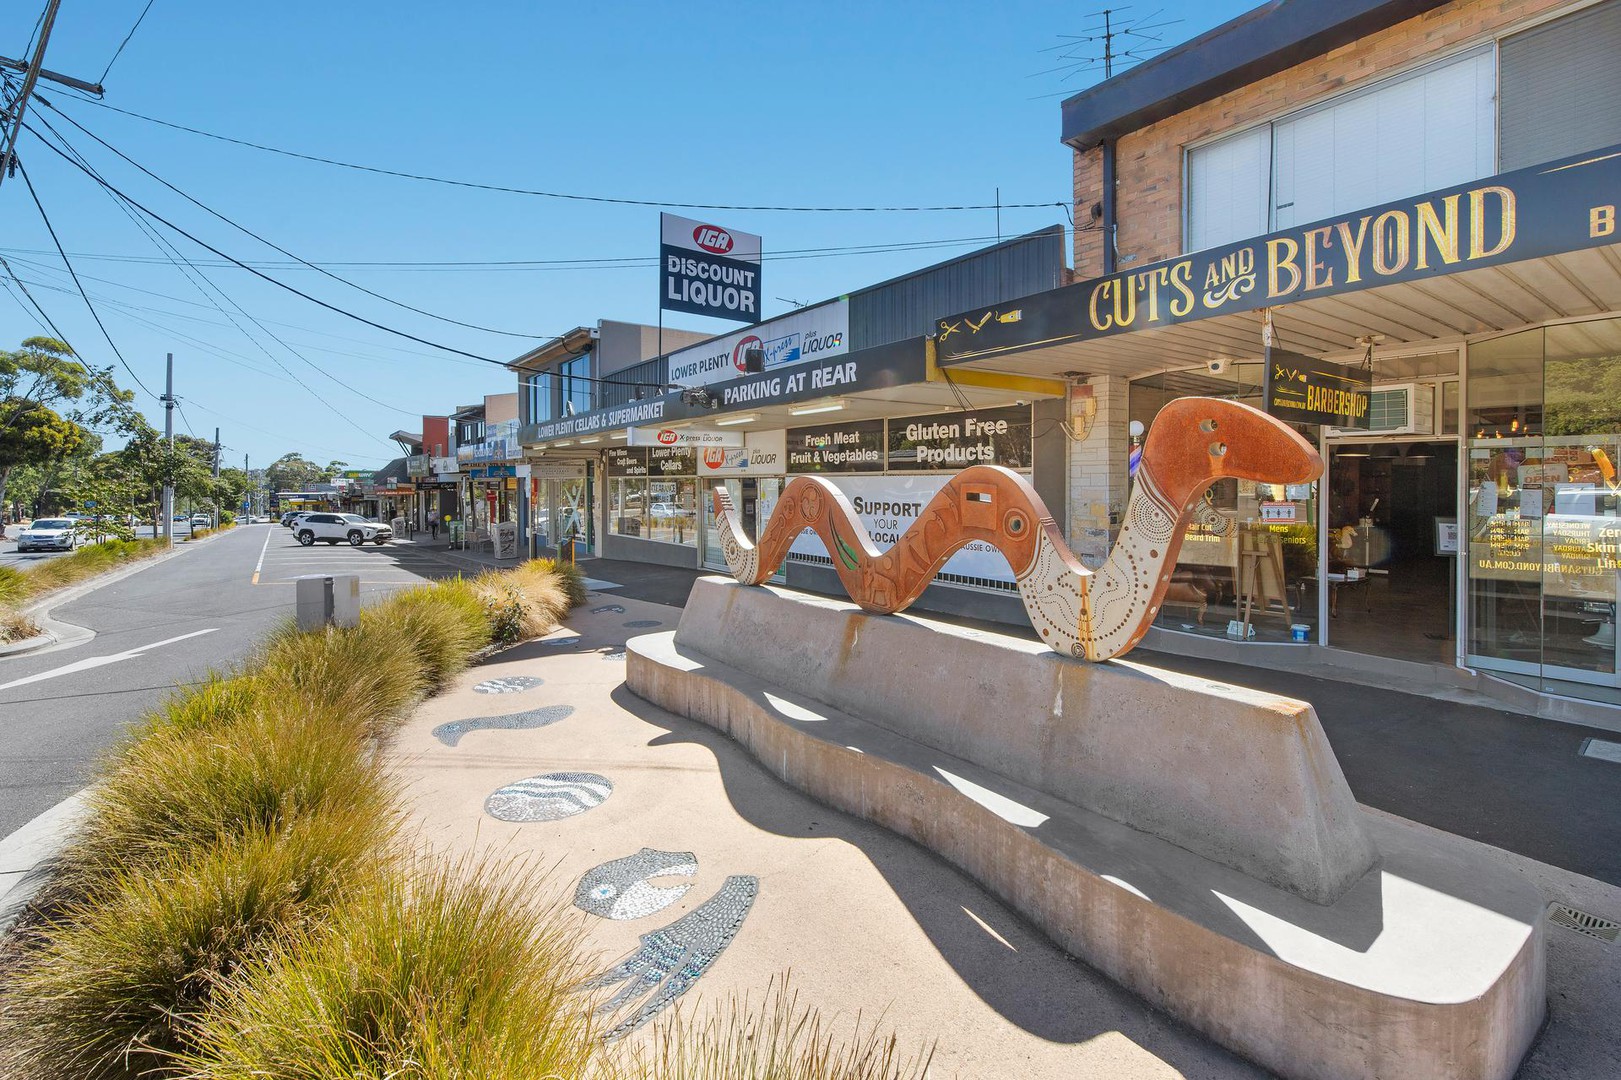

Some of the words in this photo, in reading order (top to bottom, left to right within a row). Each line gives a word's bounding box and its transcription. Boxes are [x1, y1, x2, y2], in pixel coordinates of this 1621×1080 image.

[1589, 205, 1615, 238] B
[697, 229, 730, 251] IGA
[1088, 261, 1196, 331] CUTS
[1205, 247, 1255, 289] AND
[1265, 186, 1517, 299] BEYOND
[668, 255, 755, 288] DISCOUNT
[668, 276, 754, 313] LIQUOR
[801, 332, 843, 355] LIQUOR
[804, 331, 817, 340] plus
[671, 361, 697, 381] LOWER
[699, 352, 730, 374] PLENTY
[724, 378, 780, 404] PARKING
[785, 372, 806, 394] AT
[811, 362, 857, 389] REAR
[1306, 384, 1368, 418] BARBERSHOP
[538, 425, 554, 439] LOWER
[555, 420, 574, 436] PLENTY
[574, 414, 600, 432] CELLARS
[601, 413, 606, 427] &
[608, 401, 665, 427] SUPERMARKET
[906, 422, 959, 441] Gluten
[965, 418, 1008, 437] Free
[805, 433, 831, 447] Fresh
[834, 431, 860, 445] Meat
[652, 447, 670, 457] Lower
[671, 447, 691, 457] Plenty
[750, 453, 776, 465] LIQUOR
[790, 451, 812, 464] Fruit
[813, 451, 821, 463] &
[822, 448, 879, 465] Vegetables
[916, 442, 994, 463] Products
[634, 466, 646, 475] Spirits
[660, 459, 682, 470] Cellars
[1524, 474, 1560, 484] OPEN
[853, 496, 922, 517] SUPPORT
[873, 518, 898, 530] YOUR
[1201, 523, 1213, 532] Cut
[1269, 524, 1289, 533] Mens
[1185, 533, 1204, 542] Beard
[1205, 534, 1221, 542] Trim
[1280, 536, 1307, 545] Seniors
[1587, 543, 1615, 553] Skin
